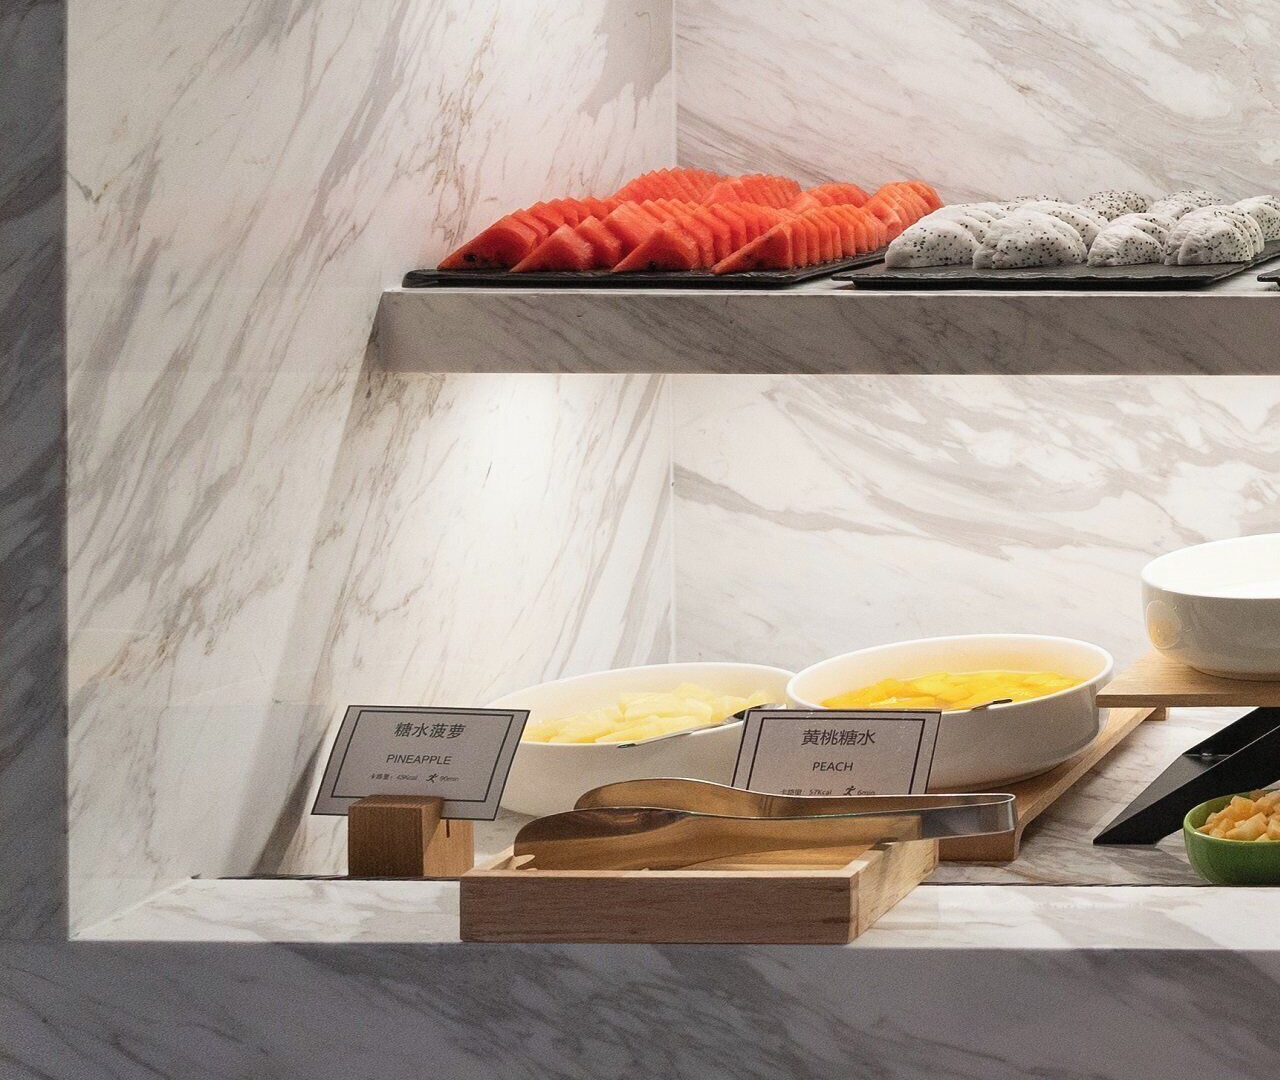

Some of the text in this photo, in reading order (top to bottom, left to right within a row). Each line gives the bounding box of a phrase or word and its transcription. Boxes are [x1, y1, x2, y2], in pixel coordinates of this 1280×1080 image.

[393, 722, 467, 739] 糖水菠萝
[801, 728, 876, 746] 黄桃糖水
[385, 754, 453, 765] PINEAPPLE
[812, 761, 854, 771] PEACH
